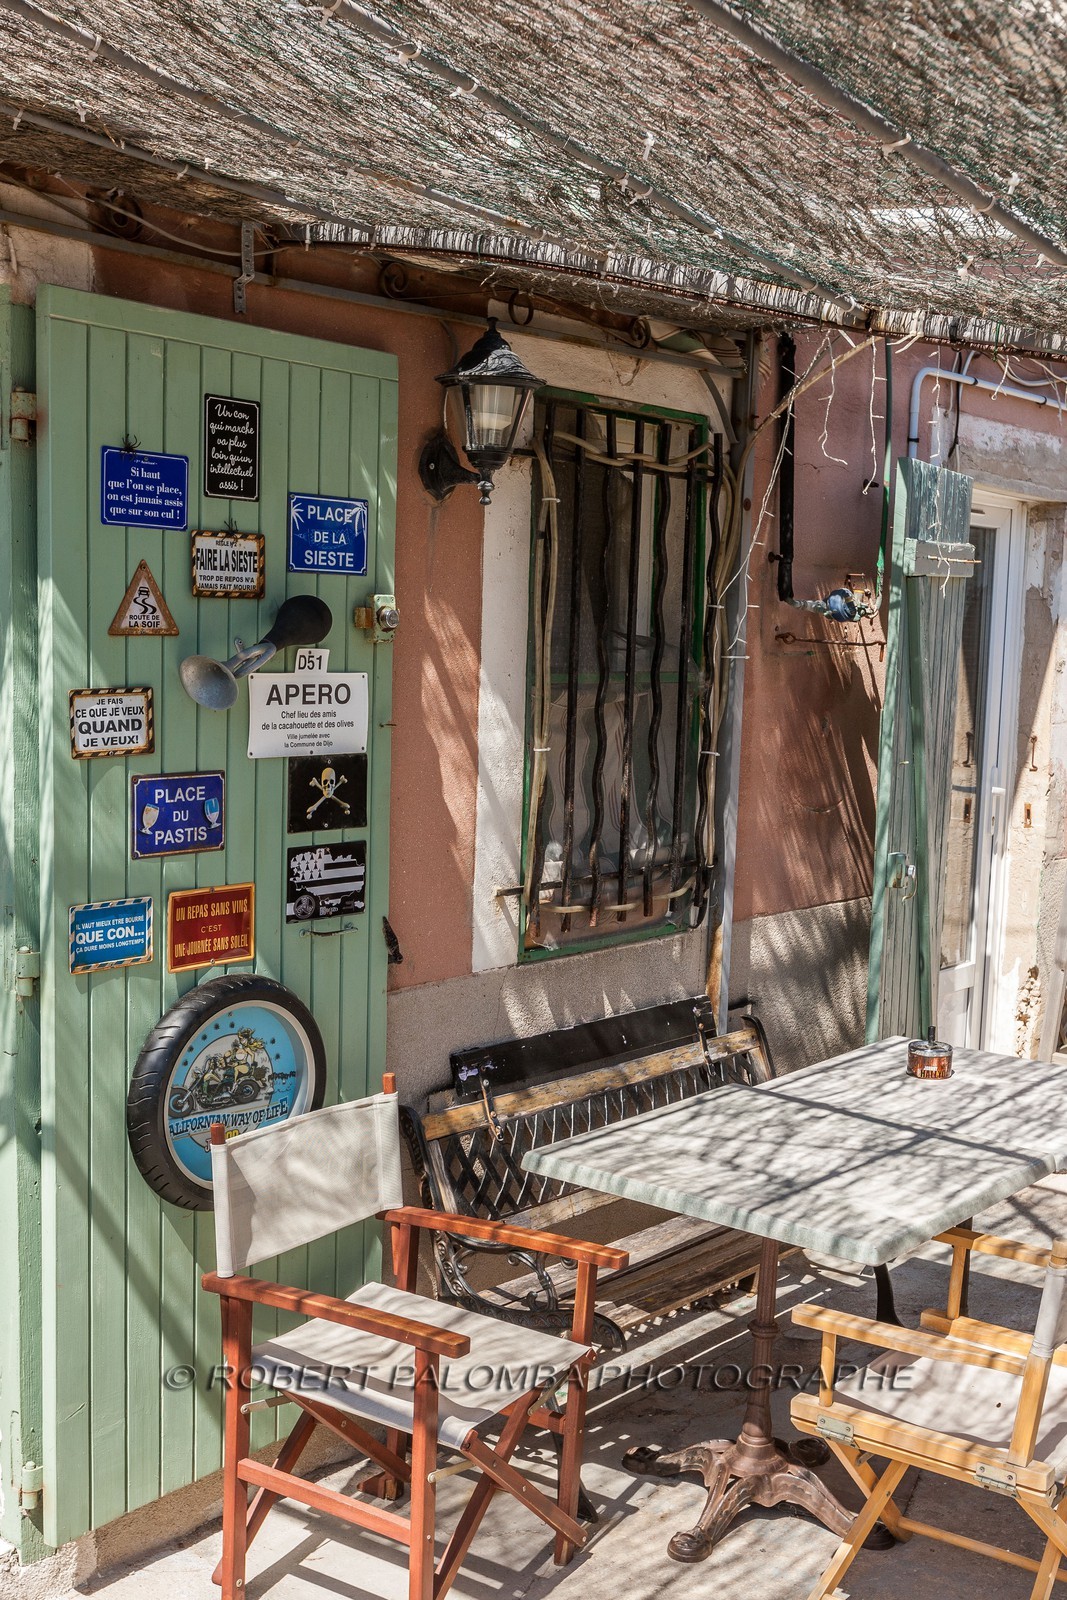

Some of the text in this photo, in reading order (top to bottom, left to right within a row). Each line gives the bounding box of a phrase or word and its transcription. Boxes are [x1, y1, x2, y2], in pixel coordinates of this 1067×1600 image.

[215, 403, 249, 420] Un con
[210, 422, 255, 434] qui marche
[228, 435, 247, 451] plus
[212, 447, 252, 466] loin qu'un
[130, 466, 160, 479] Si haut
[210, 463, 253, 477] intellectuel
[108, 480, 124, 489] que
[156, 483, 182, 496] place,
[219, 481, 238, 490] assis
[120, 494, 133, 502] est
[134, 494, 162, 505] jamais
[164, 498, 183, 507] assis
[110, 506, 126, 516] que
[161, 509, 174, 519] cul
[307, 505, 352, 523] PLACE
[314, 531, 347, 545] DE LA
[196, 548, 258, 572] FAIRE LA SIESTE
[304, 550, 354, 567] SIESTE
[298, 655, 322, 670] D51
[266, 683, 351, 705] APERO
[75, 706, 144, 718] CE QUE JE VEUX
[281, 711, 296, 719] Chef
[78, 718, 142, 735] QUAND
[261, 723, 270, 731] de
[279, 722, 316, 730] cacahouette
[83, 738, 98, 747] JE
[155, 786, 206, 804] PLACE
[173, 810, 189, 822] DU
[155, 826, 207, 845] PASTIS
[176, 898, 248, 921] UN REPAS SANS VINS
[81, 922, 95, 930] VAUT
[96, 920, 111, 928] MIEUX
[201, 924, 222, 933] C'EST
[75, 925, 145, 944] QUE CON...
[99, 942, 115, 950] MOINS
[115, 938, 144, 947] LONGTEMPS
[174, 934, 248, 958] UNE JOURNÉE SANS SOLEIL
[168, 1113, 231, 1137] ALIFORNIAN
[230, 1112, 252, 1127] WAY
[252, 1110, 265, 1124] OF
[265, 1097, 288, 1120] LIFE
